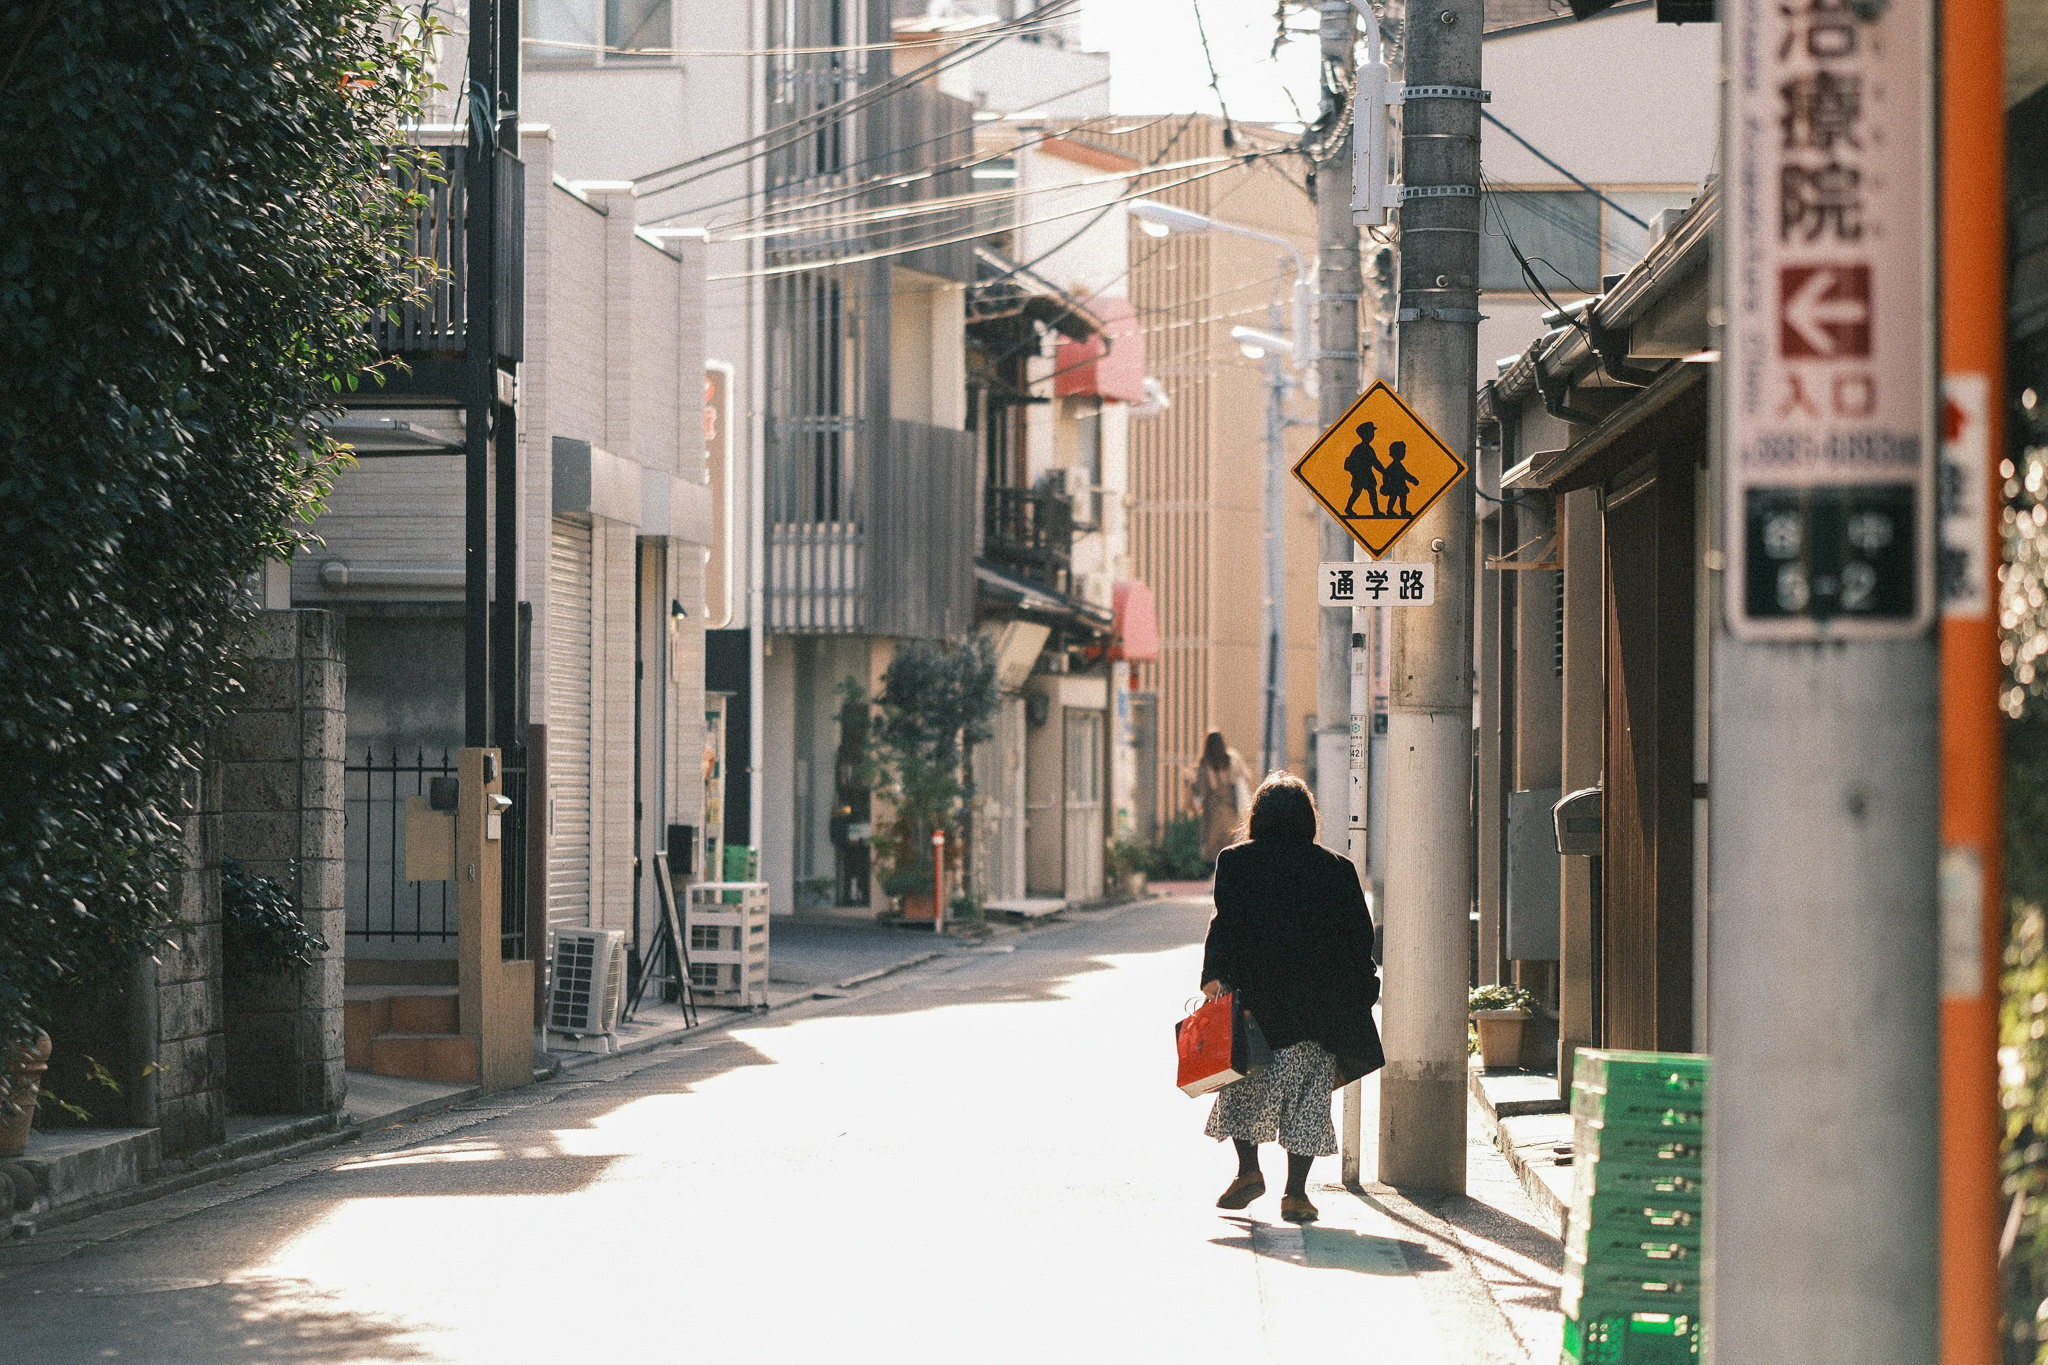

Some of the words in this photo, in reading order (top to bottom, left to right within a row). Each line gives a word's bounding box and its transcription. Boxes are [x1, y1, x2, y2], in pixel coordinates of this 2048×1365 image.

[1775, 370, 1878, 419] 入口
[1329, 569, 1425, 600] 通学路
